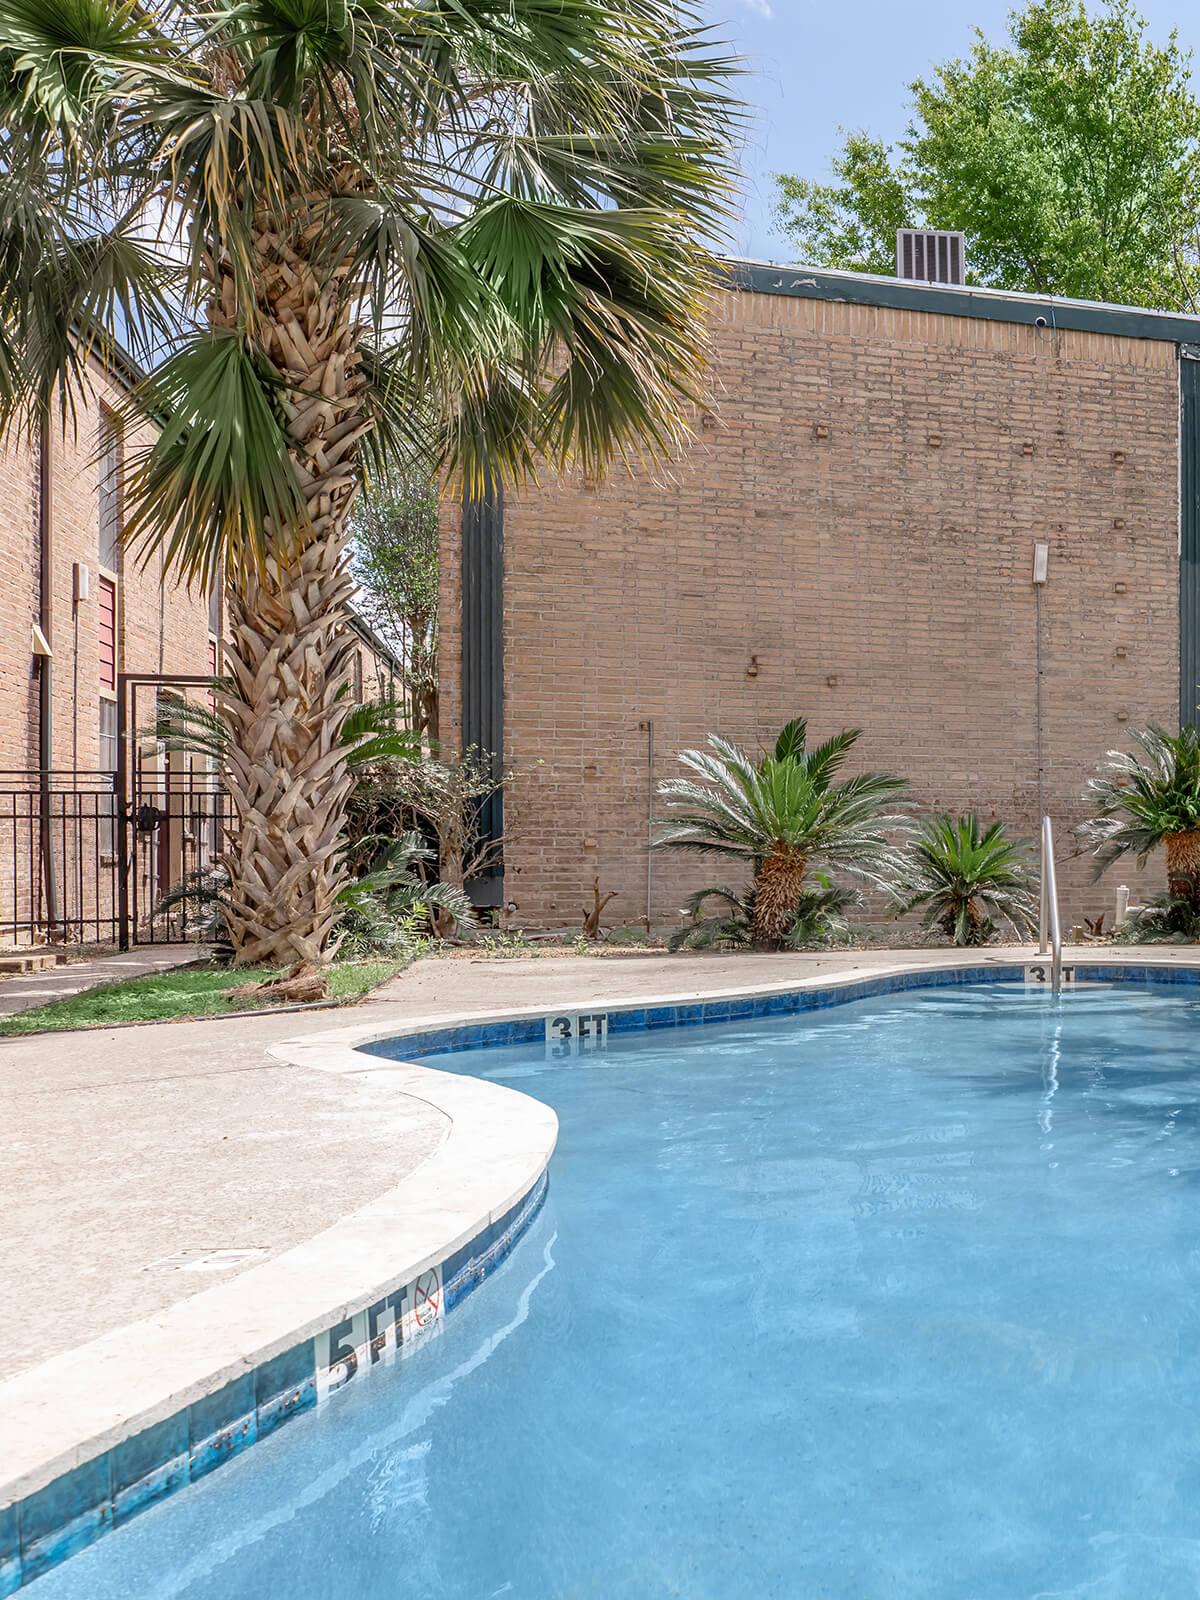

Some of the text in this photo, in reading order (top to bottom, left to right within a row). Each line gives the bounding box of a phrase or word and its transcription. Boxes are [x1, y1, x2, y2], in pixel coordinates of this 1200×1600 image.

[1030, 966, 1074, 983] 3 T
[551, 1014, 606, 1039] 3 FT
[328, 1286, 408, 1393] 5 FT
